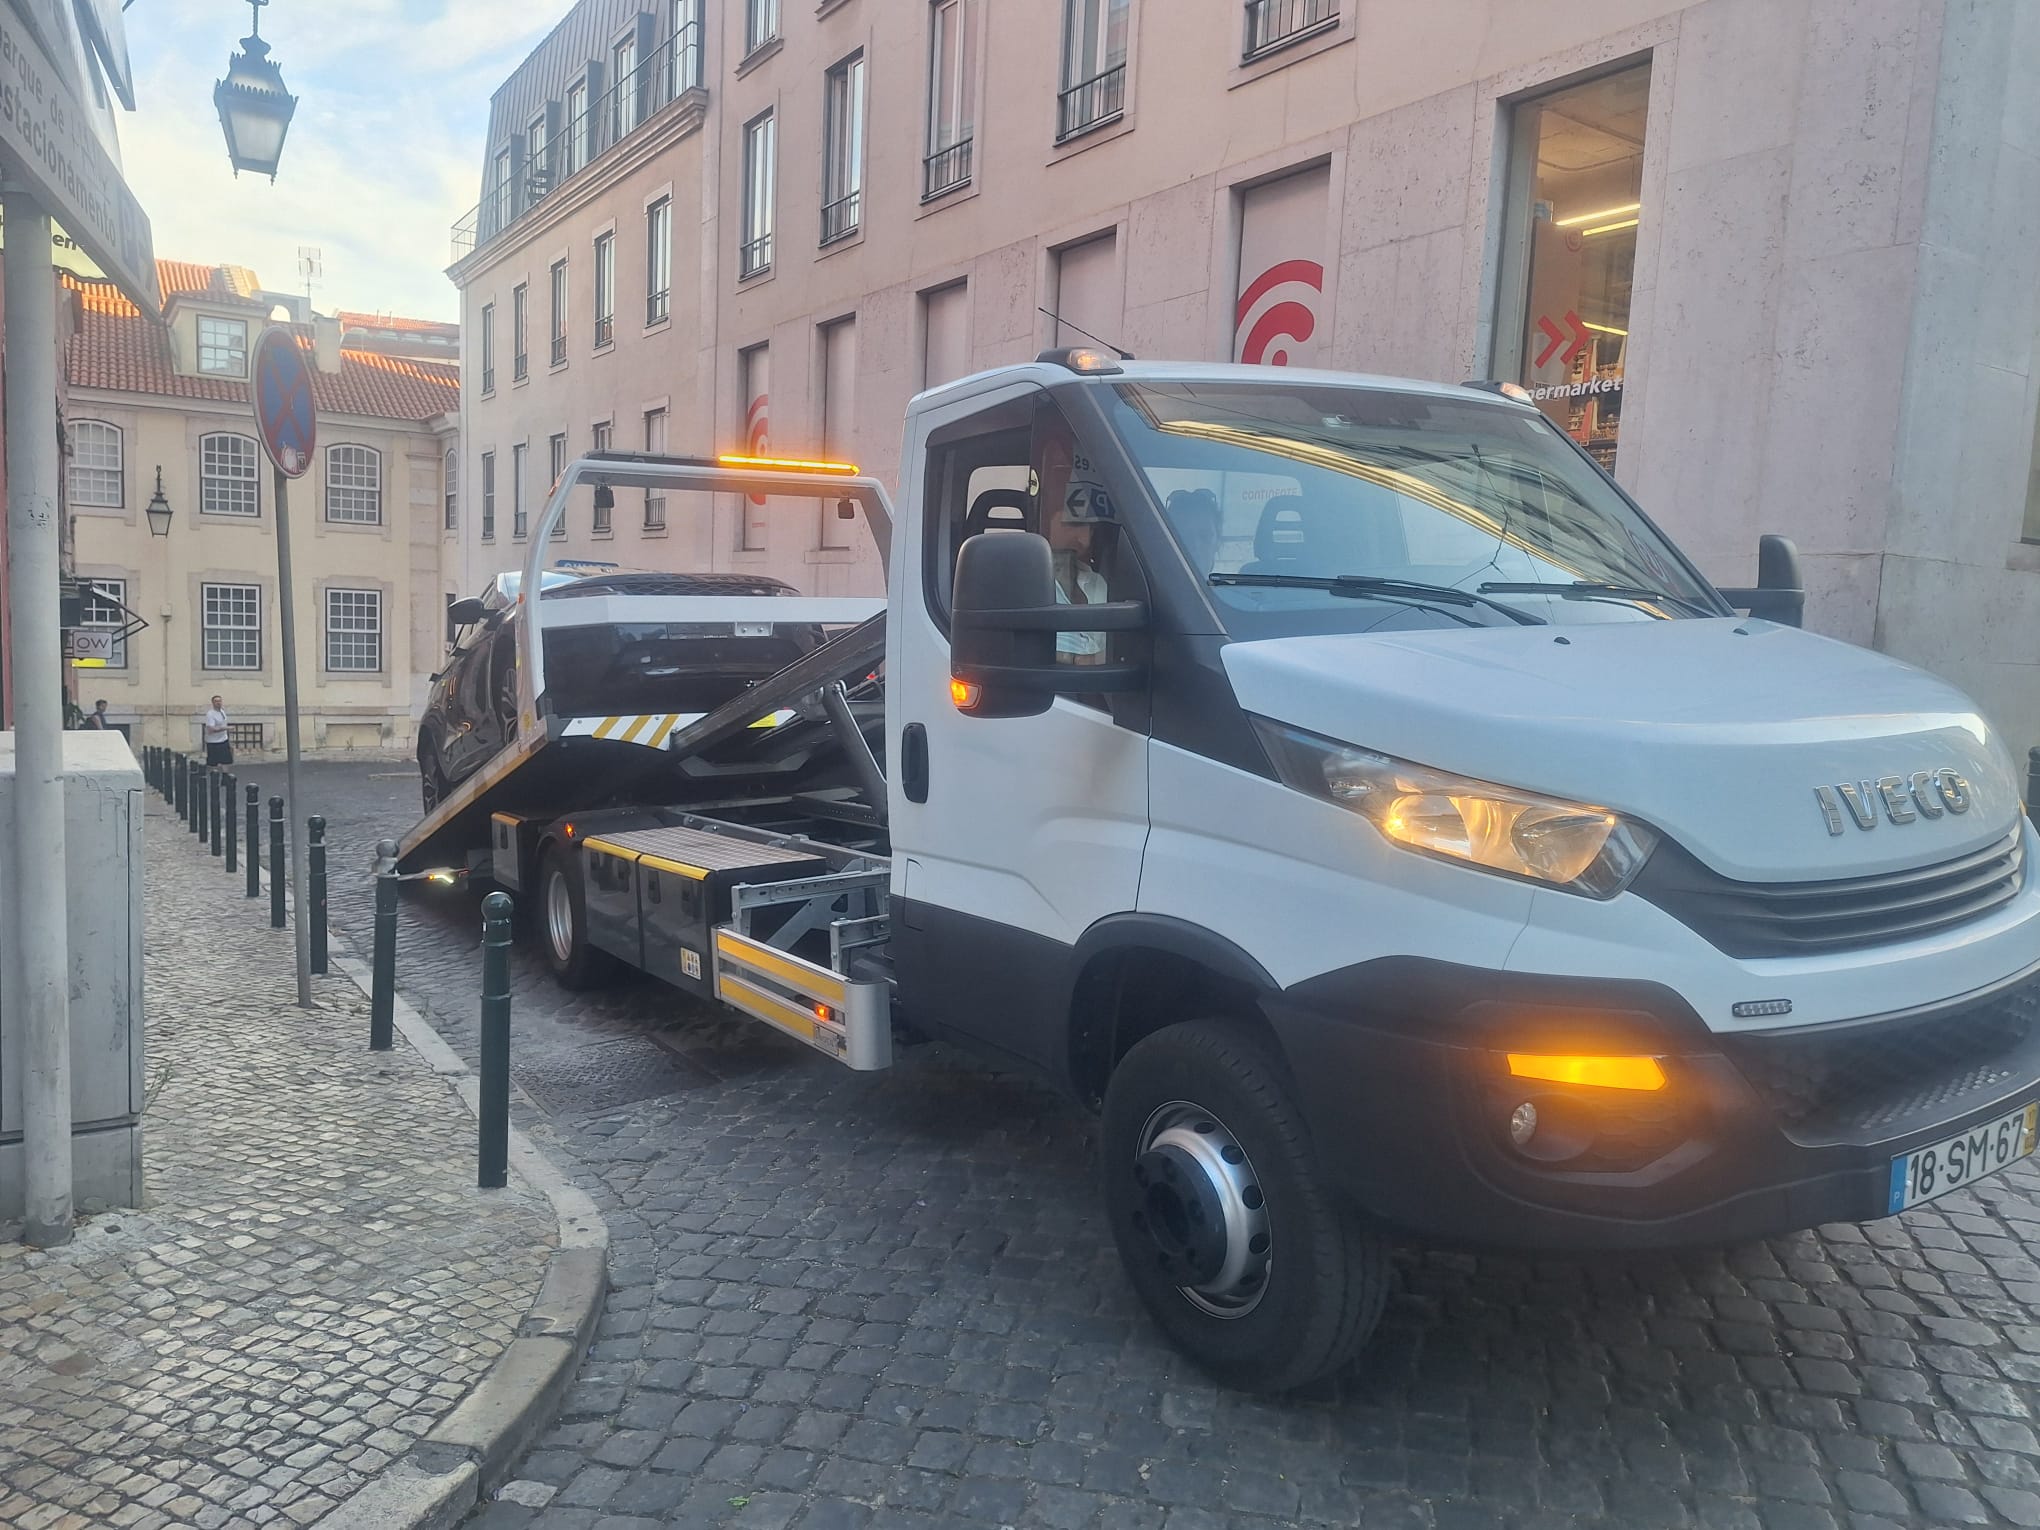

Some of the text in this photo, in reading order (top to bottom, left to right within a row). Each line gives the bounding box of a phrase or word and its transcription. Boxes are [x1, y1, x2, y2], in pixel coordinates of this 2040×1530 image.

[0, 24, 65, 135] arque de
[0, 82, 116, 247] stacionamento
[76, 637, 109, 649] OW
[1814, 767, 1971, 837] IVECO
